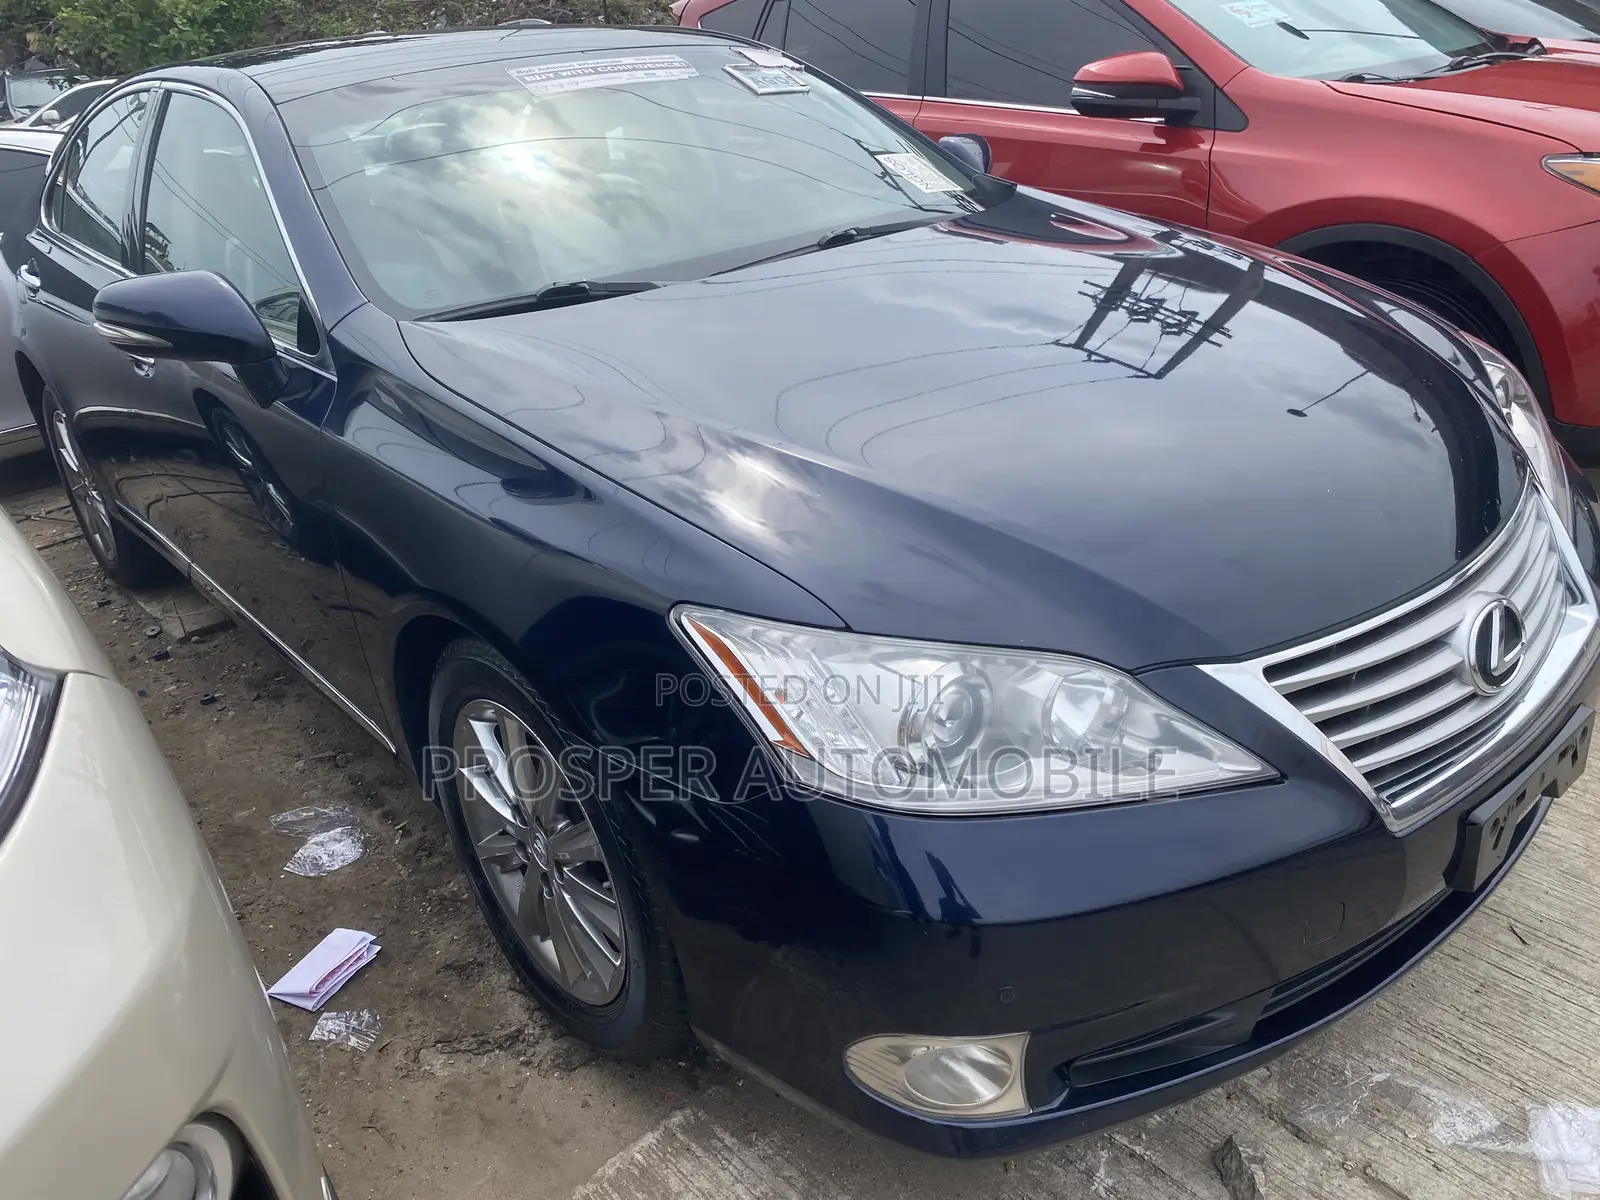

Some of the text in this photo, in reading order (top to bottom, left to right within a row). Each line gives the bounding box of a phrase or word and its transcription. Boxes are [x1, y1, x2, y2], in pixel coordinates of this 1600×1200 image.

[523, 60, 686, 82] BUY WITH CONFIDENCE!
